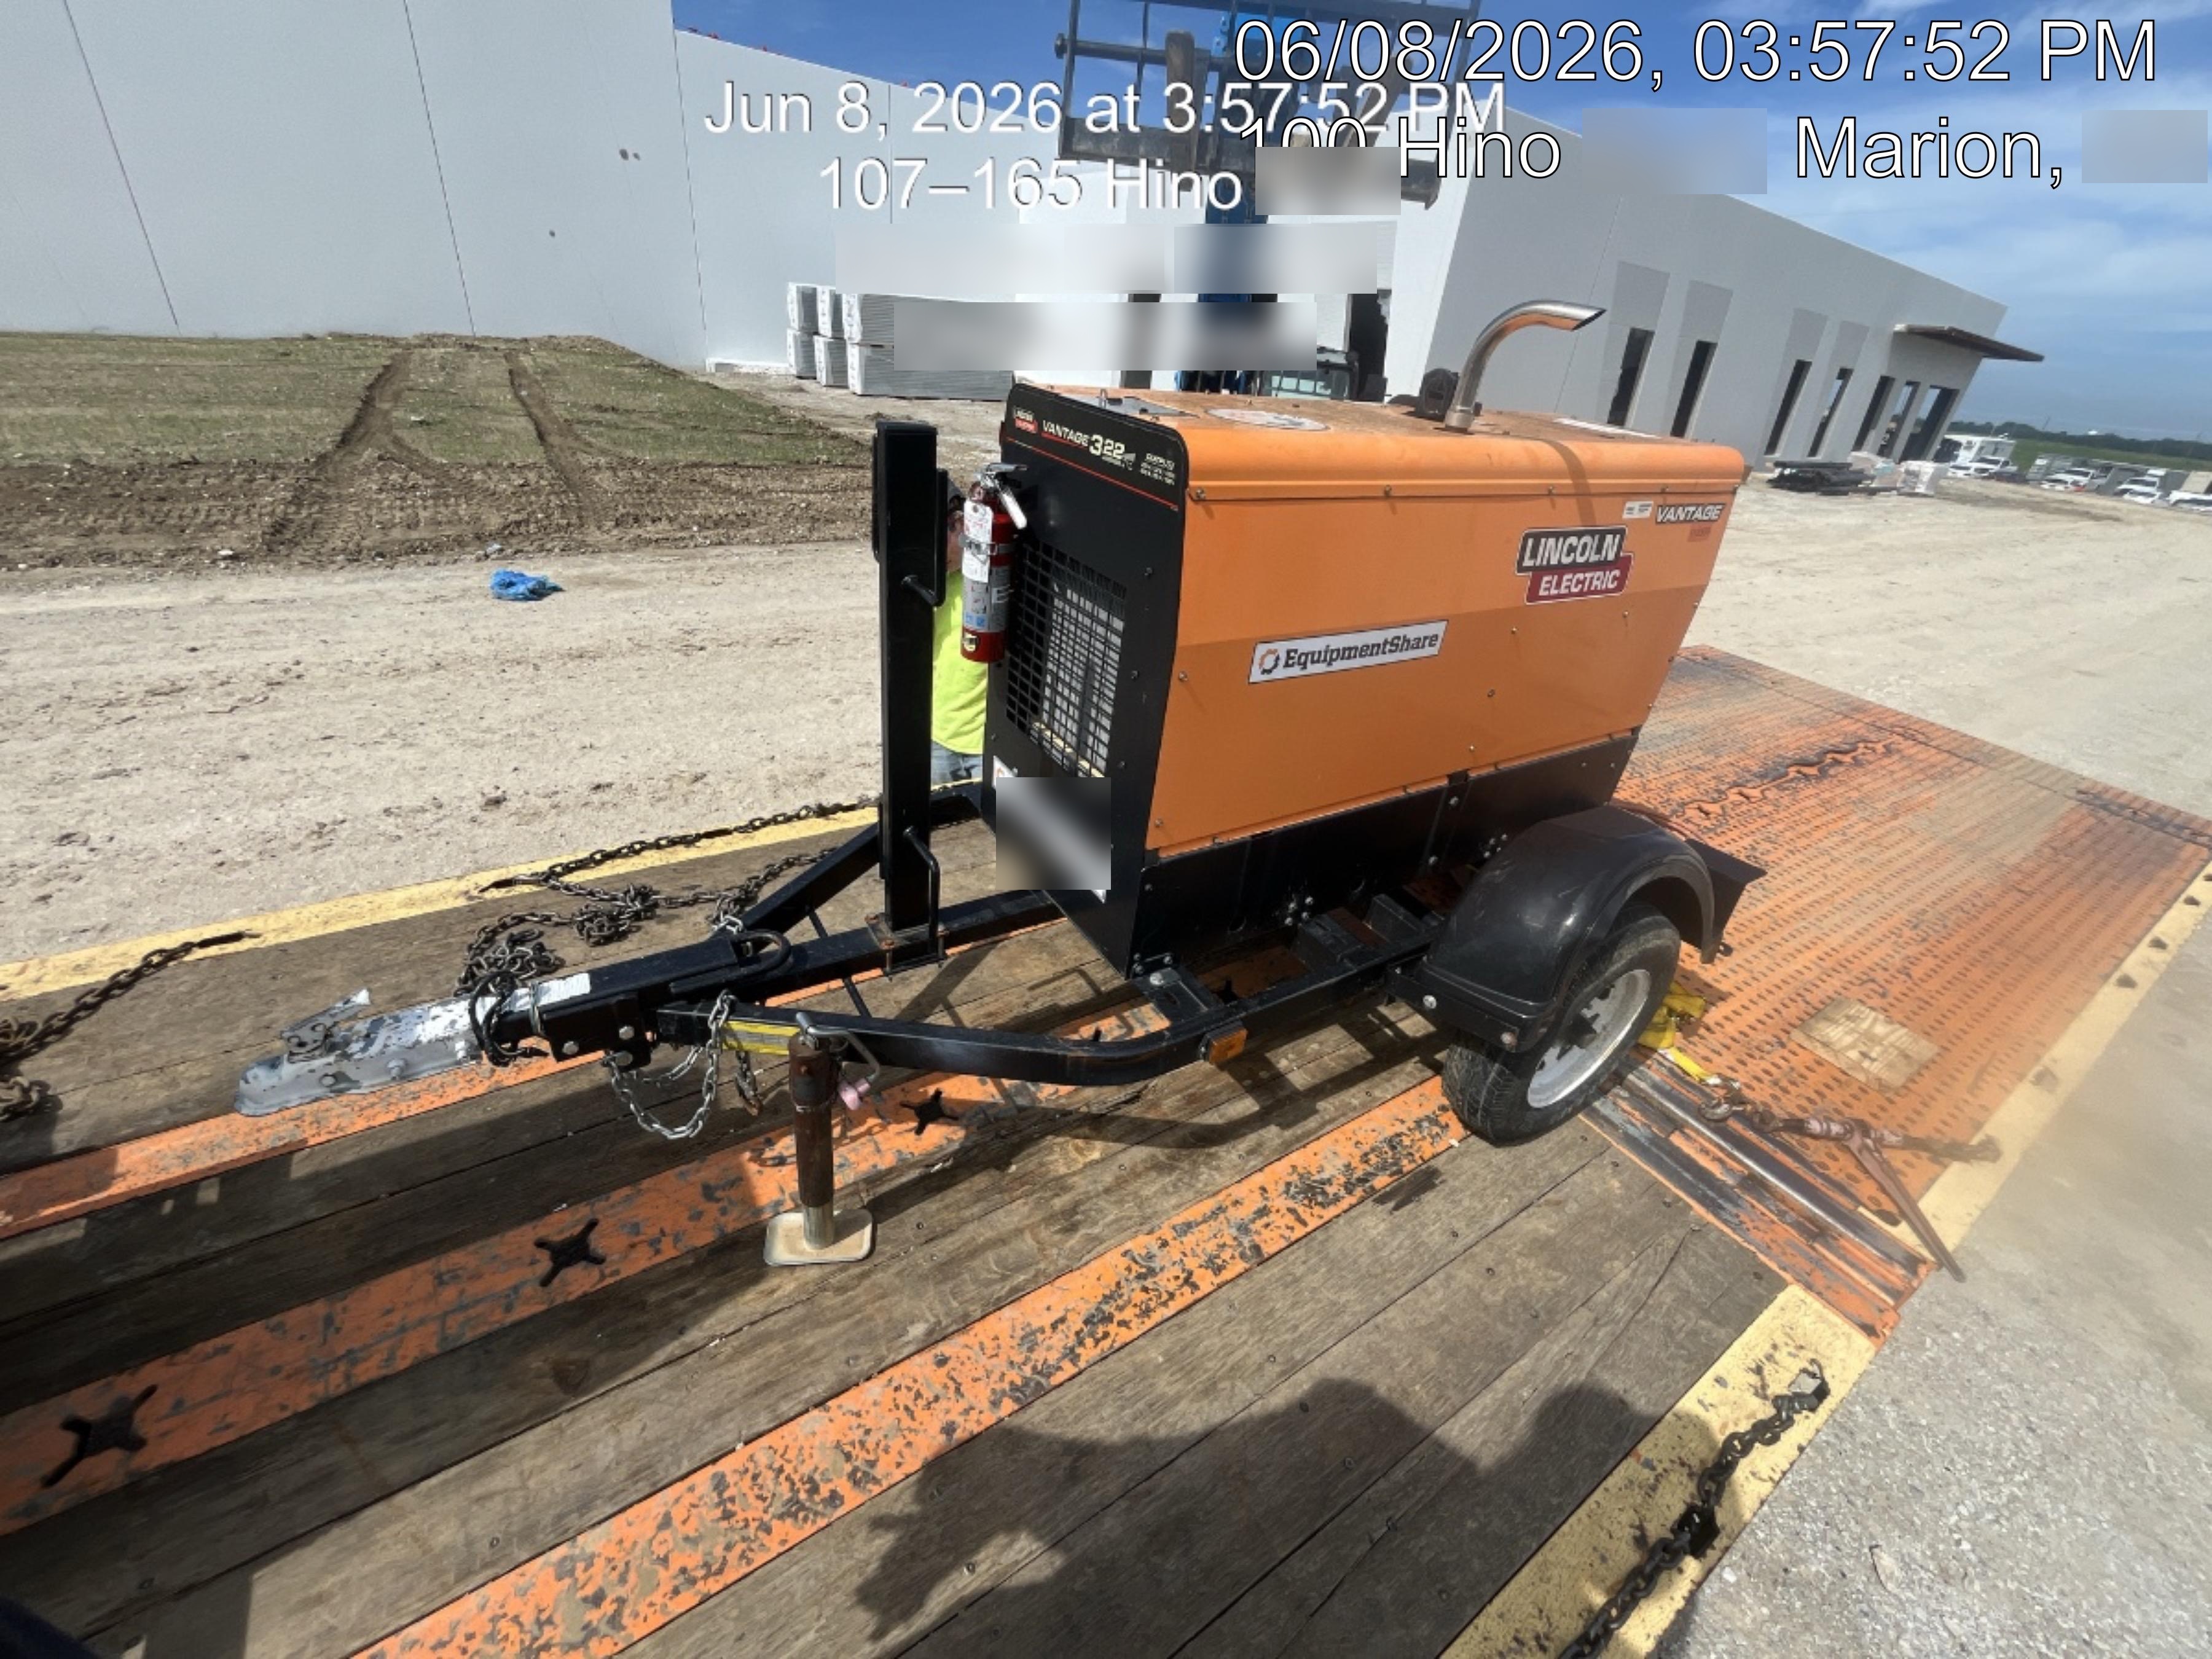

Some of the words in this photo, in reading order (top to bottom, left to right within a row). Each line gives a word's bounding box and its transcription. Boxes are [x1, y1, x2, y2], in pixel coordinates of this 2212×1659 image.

[1089, 434, 1126, 460] 322
[1657, 504, 1723, 522] VANTAGE
[1522, 533, 1621, 567] LINCOLN
[1538, 569, 1621, 597] ELECTRIC
[1282, 633, 1439, 670] EquipmentShare
